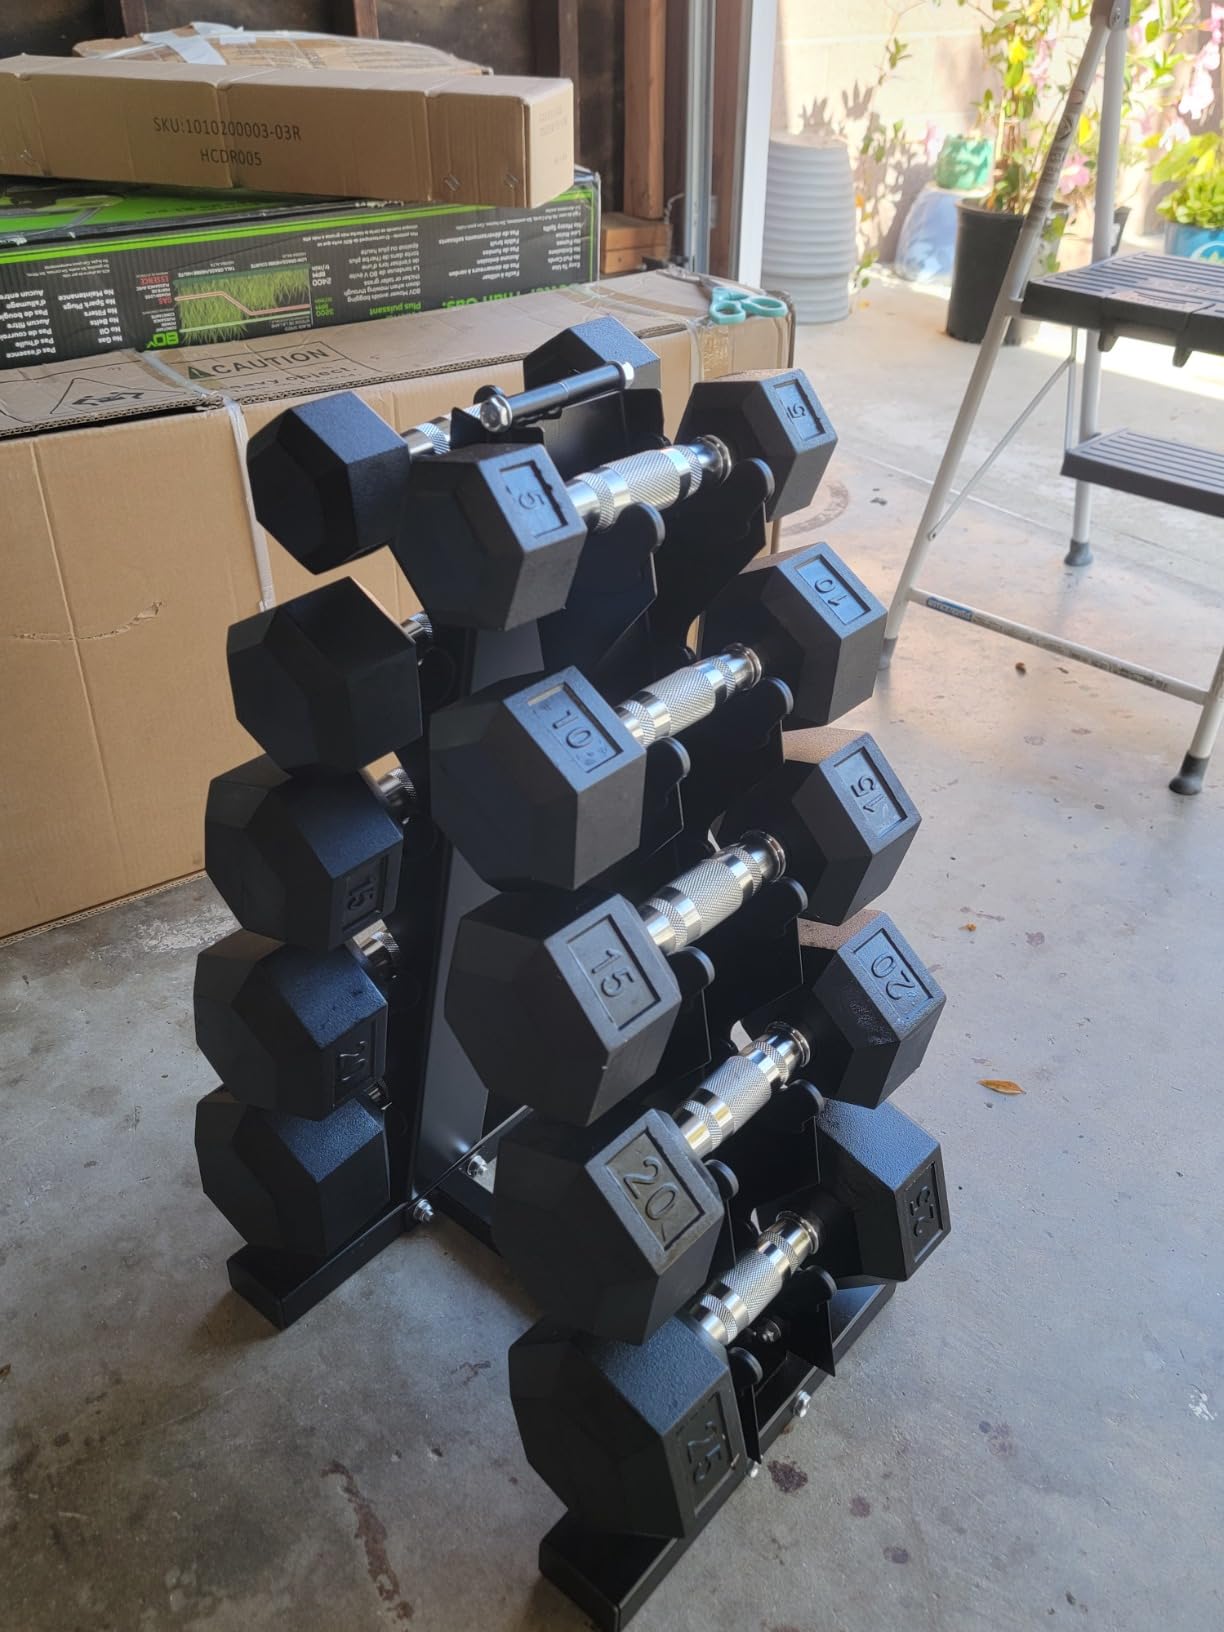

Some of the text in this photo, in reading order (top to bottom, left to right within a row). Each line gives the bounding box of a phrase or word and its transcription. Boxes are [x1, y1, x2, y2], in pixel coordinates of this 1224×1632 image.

[153, 116, 302, 141] SKU:1010200003-03R
[200, 148, 262, 166] HCDR005
[312, 277, 331, 286] 2400
[20, 289, 44, 297] Aucun
[58, 290, 103, 301] Maintenance
[6, 299, 46, 309] d'allumage
[63, 302, 83, 310] Plugs
[84, 299, 105, 308] Spark
[26, 318, 50, 326] Aucun
[89, 318, 108, 326] Belts
[15, 339, 39, 348] d'huile
[6, 348, 42, 358] d'essence
[211, 348, 330, 376] CAUTION
[786, 403, 807, 419] 5
[814, 578, 849, 607] 10
[551, 709, 593, 750] 10
[850, 774, 886, 814] 15
[591, 948, 635, 998] 15
[871, 951, 916, 1001] 20
[623, 1156, 680, 1221] 20
[908, 1185, 936, 1238] 25
[687, 1420, 722, 1486] 25
